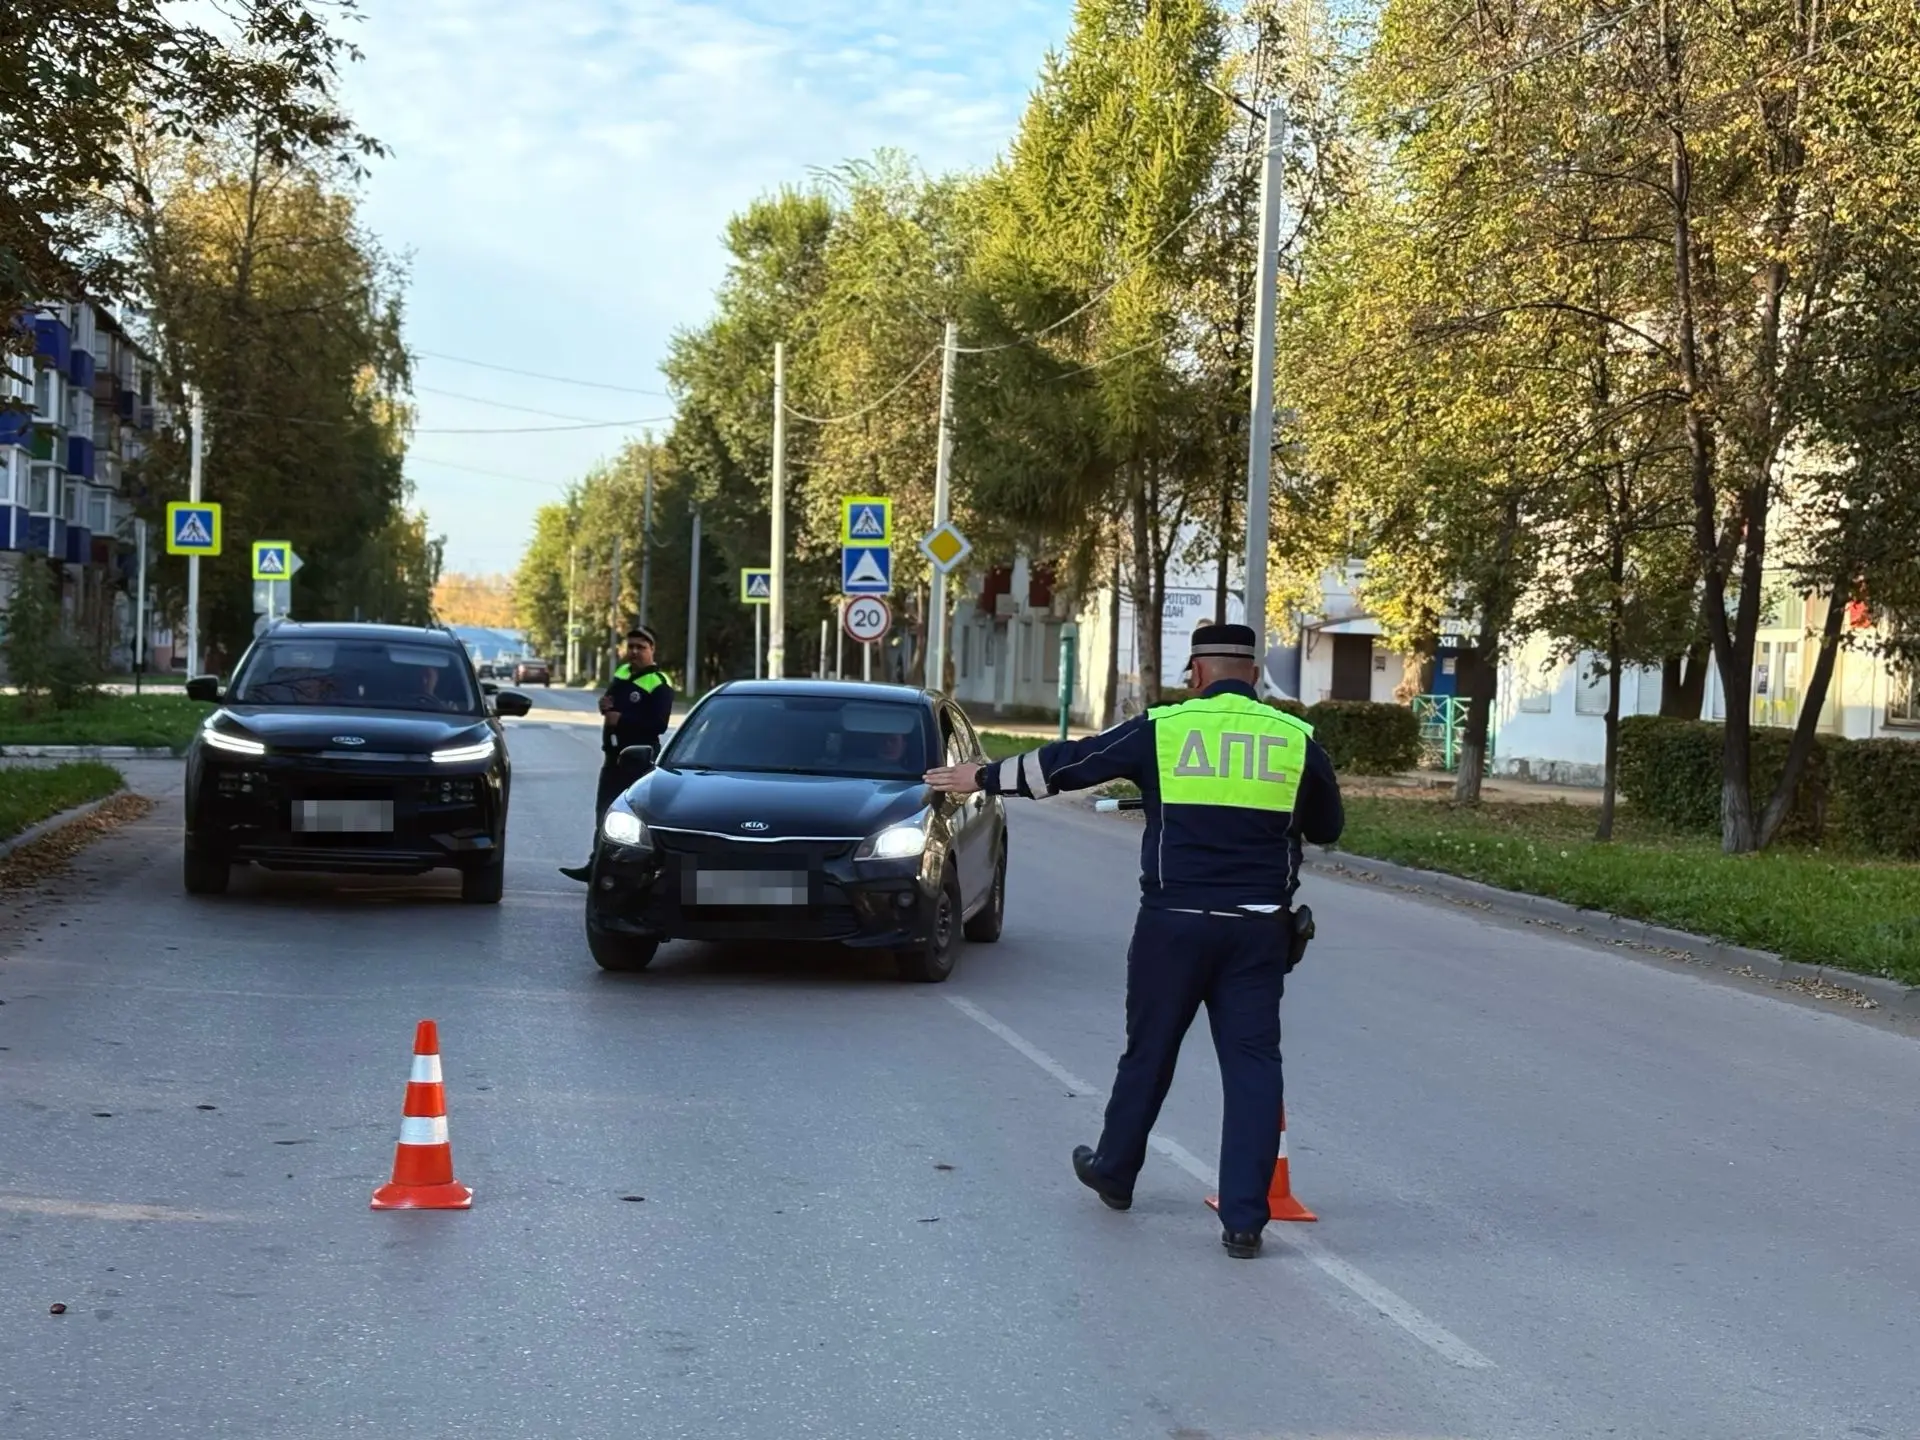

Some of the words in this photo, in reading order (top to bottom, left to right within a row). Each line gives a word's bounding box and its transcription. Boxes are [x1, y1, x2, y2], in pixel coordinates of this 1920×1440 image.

[1163, 592, 1202, 606] РОТСТВО
[854, 609, 880, 627] 20
[1162, 605, 1184, 618] ДАН
[1437, 636, 1458, 648] ХИ
[1173, 729, 1288, 784] ДПС
